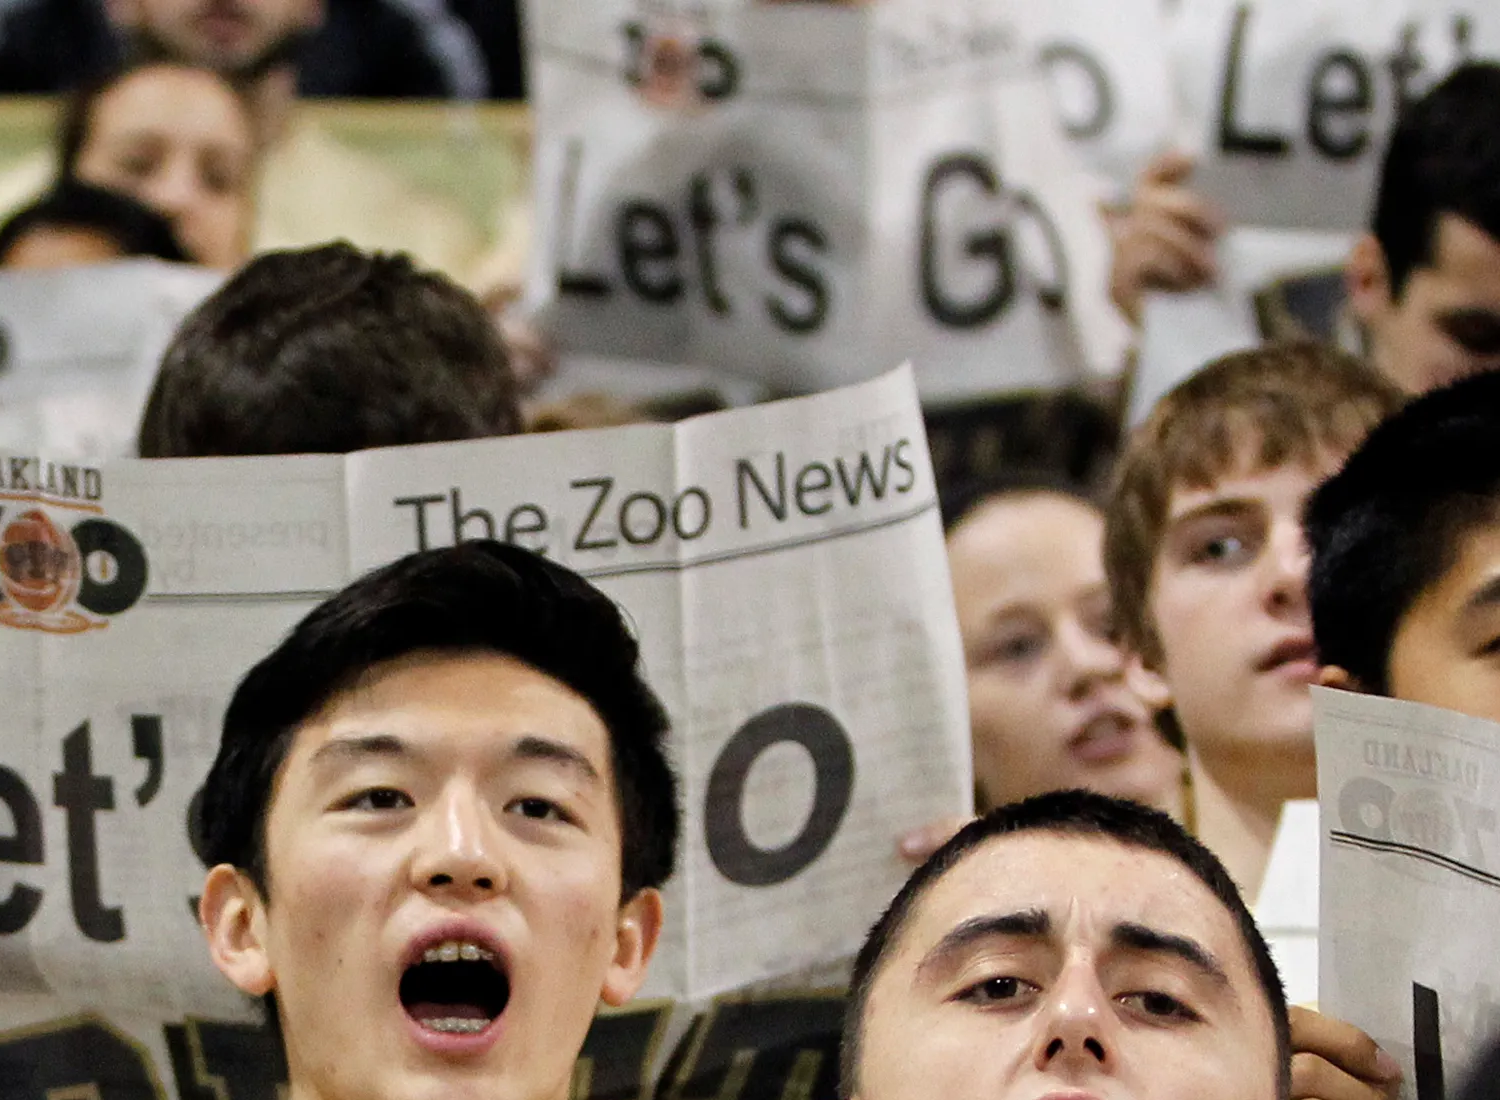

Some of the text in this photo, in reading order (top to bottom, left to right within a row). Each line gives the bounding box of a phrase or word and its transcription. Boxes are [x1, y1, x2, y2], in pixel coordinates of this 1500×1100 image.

[1216, 5, 1472, 158] Let'
[569, 477, 713, 552] Zoo
[735, 437, 916, 529] News
